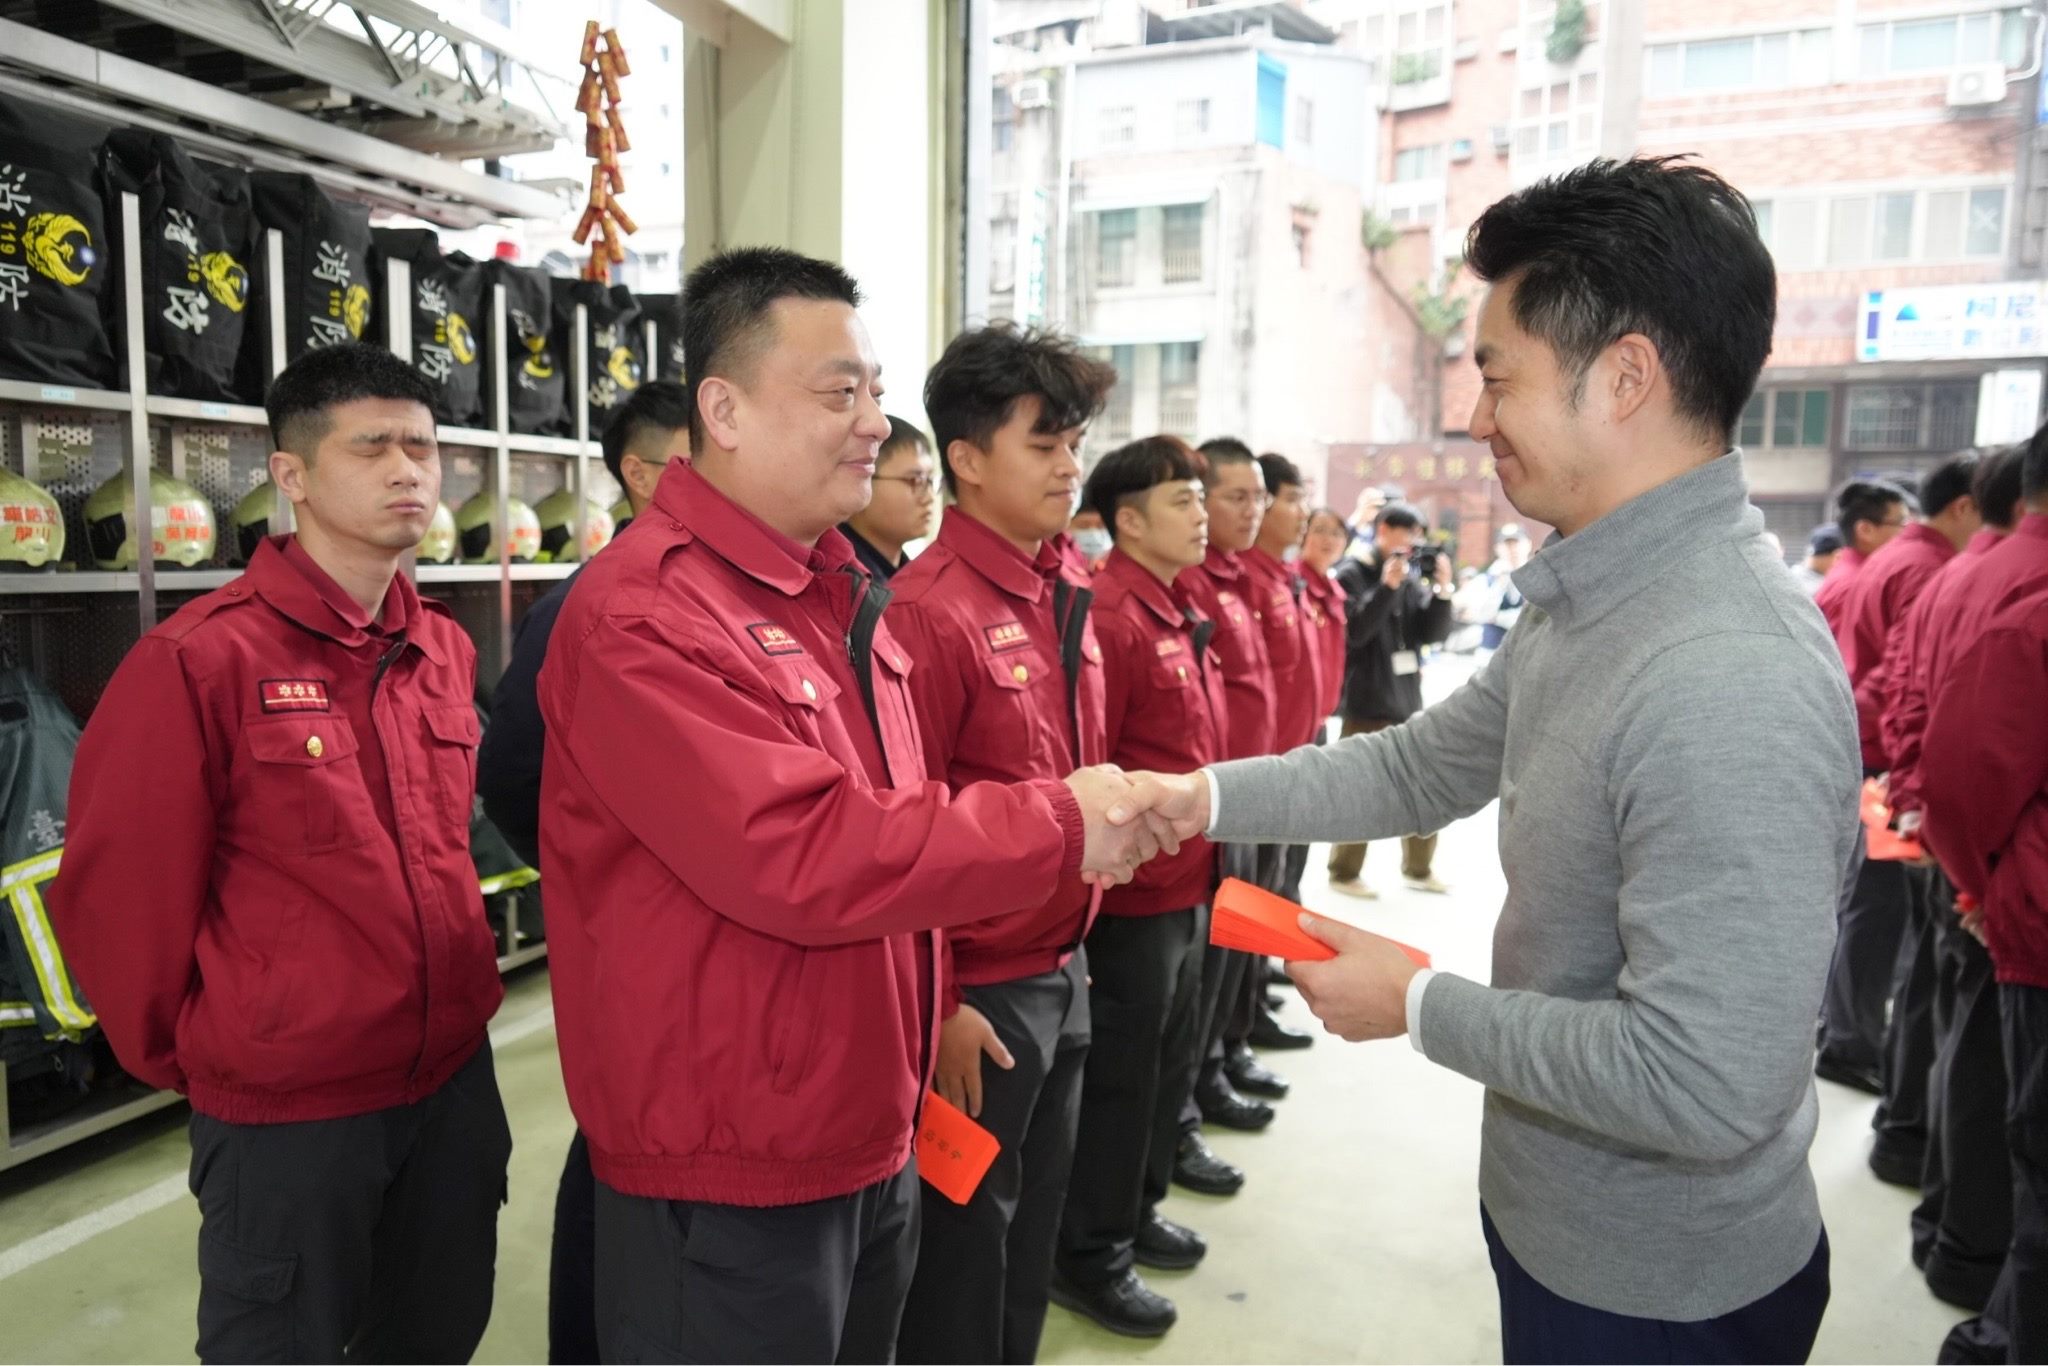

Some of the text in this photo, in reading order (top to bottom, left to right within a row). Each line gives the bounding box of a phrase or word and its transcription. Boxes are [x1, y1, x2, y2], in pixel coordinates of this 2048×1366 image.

[0, 221, 16, 255] 119
[312, 240, 351, 288] 消
[163, 286, 209, 335] 防
[328, 289, 342, 317] 119
[418, 278, 448, 317] 消
[418, 343, 455, 385] 防
